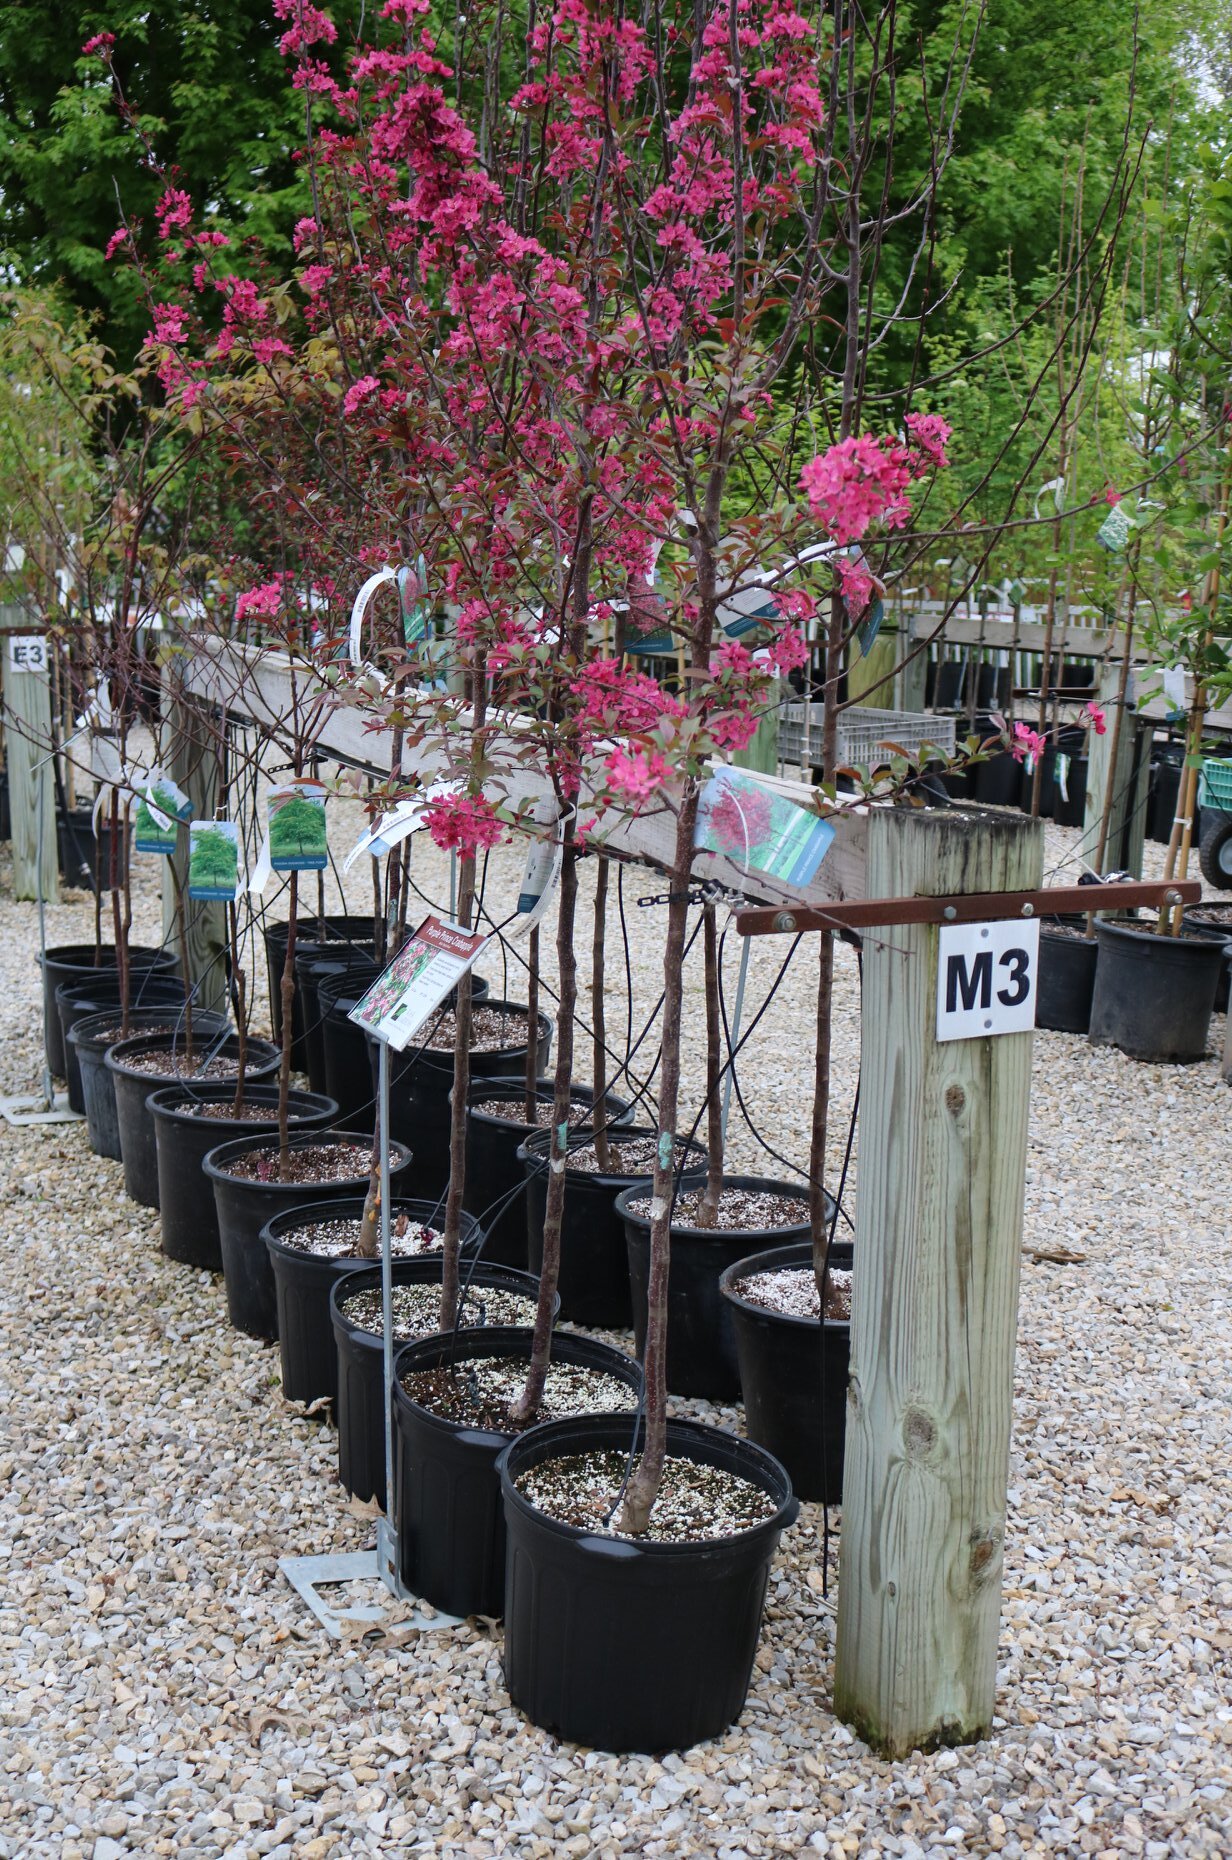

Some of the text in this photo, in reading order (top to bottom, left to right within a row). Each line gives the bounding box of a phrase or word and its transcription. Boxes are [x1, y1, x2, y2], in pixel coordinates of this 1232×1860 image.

[14, 645, 43, 664] E3
[426, 925, 442, 939] Purple
[438, 930, 455, 944] Prince
[451, 935, 474, 952] Crabapple
[946, 948, 1030, 1013] M3
